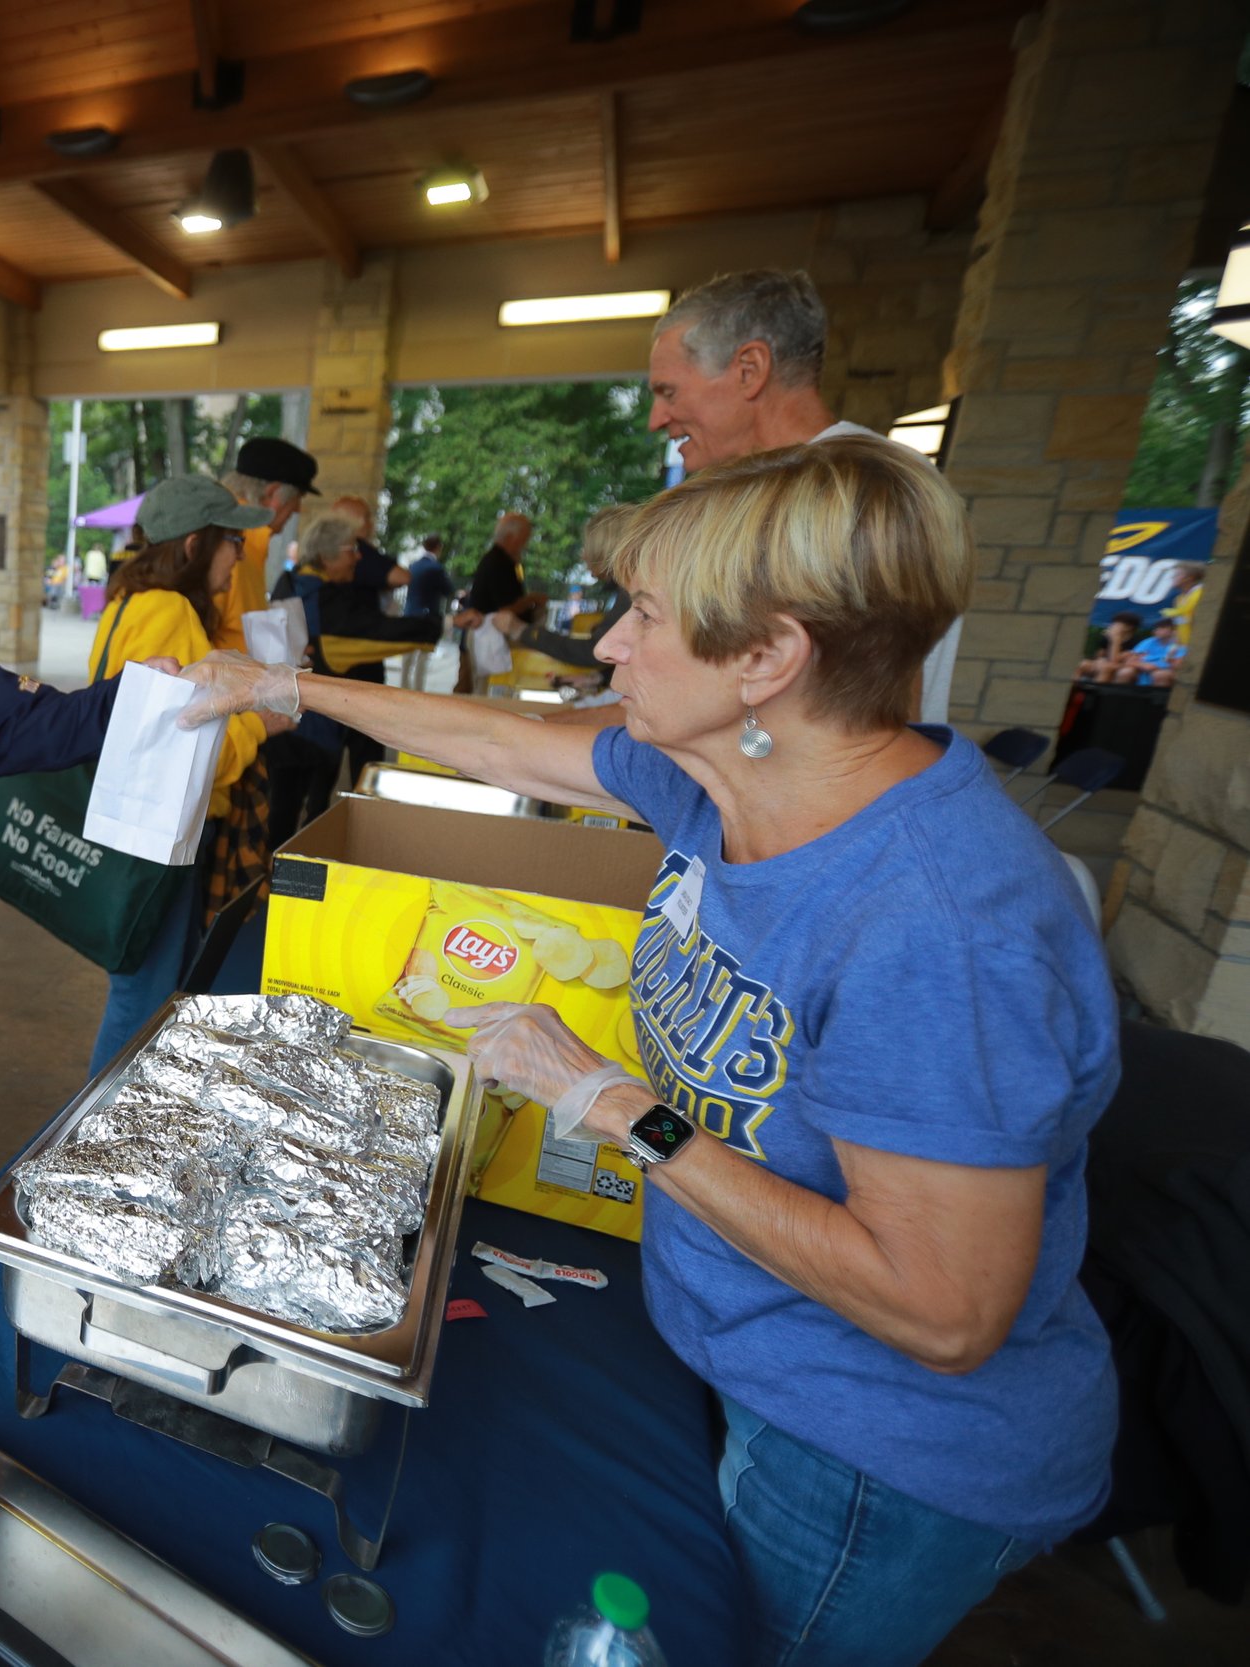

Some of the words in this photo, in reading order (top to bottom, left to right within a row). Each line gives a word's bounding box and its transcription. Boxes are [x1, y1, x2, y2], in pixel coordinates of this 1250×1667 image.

[6, 797, 35, 827] No
[35, 814, 104, 867] Farms
[1, 822, 30, 854] No
[31, 841, 87, 888] Food
[445, 926, 515, 970] Lay's
[327, 989, 341, 997] EACH
[441, 973, 486, 1000] Classic
[638, 1020, 734, 1140] TOLEDO
[554, 1267, 579, 1279] GOLD
